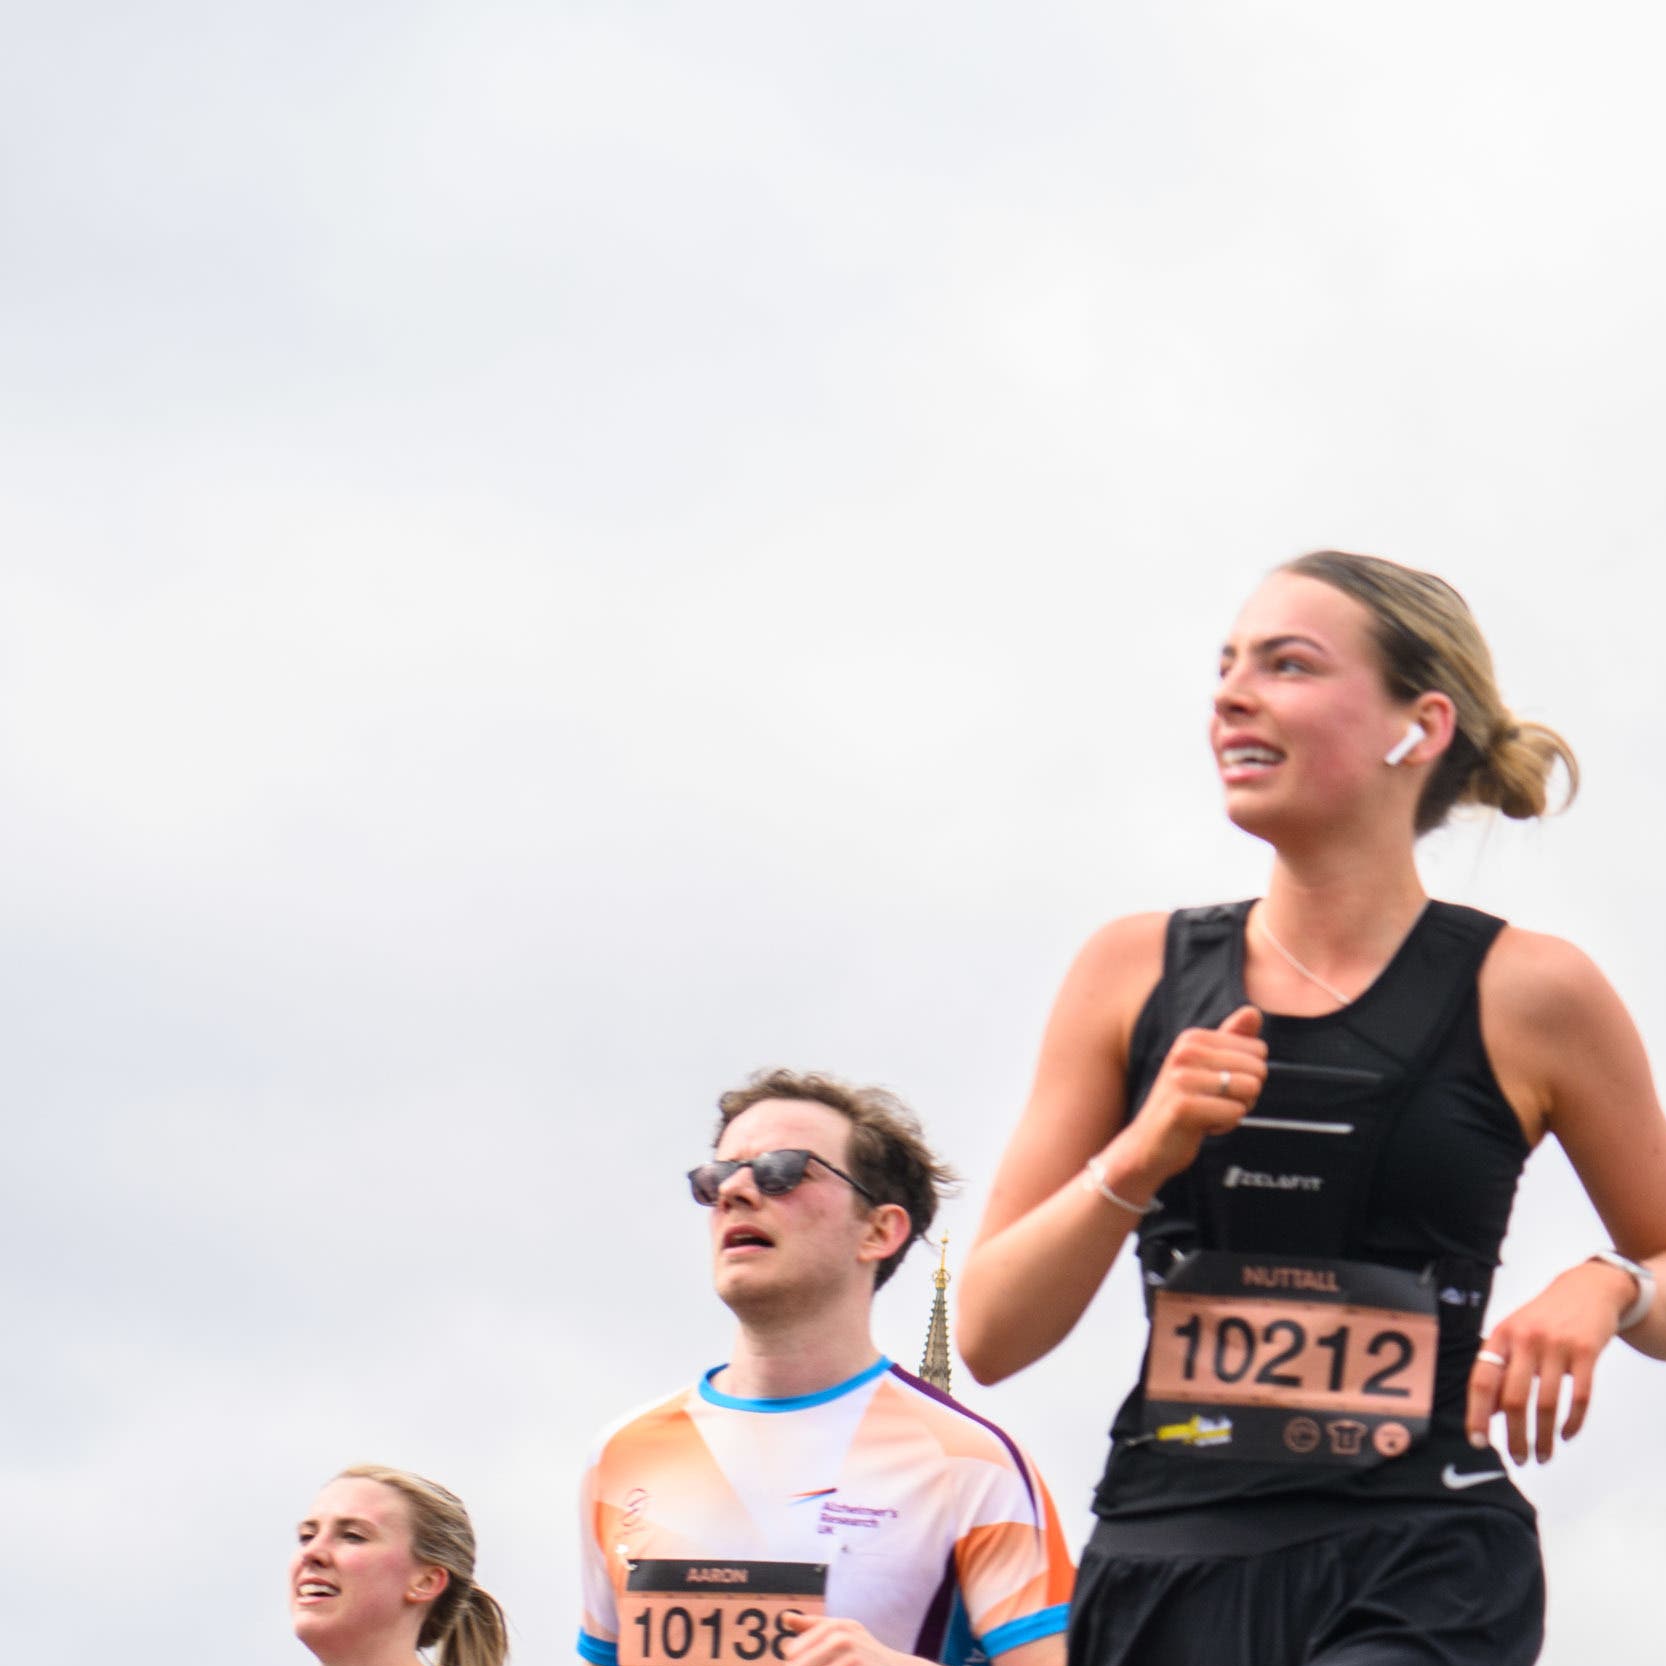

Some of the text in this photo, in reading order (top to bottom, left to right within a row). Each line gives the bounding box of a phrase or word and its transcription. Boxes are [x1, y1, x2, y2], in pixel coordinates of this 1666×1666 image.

[1240, 1264, 1340, 1292] NUTTALL
[1174, 1314, 1415, 1398] 10212
[685, 1566, 749, 1584] AARON
